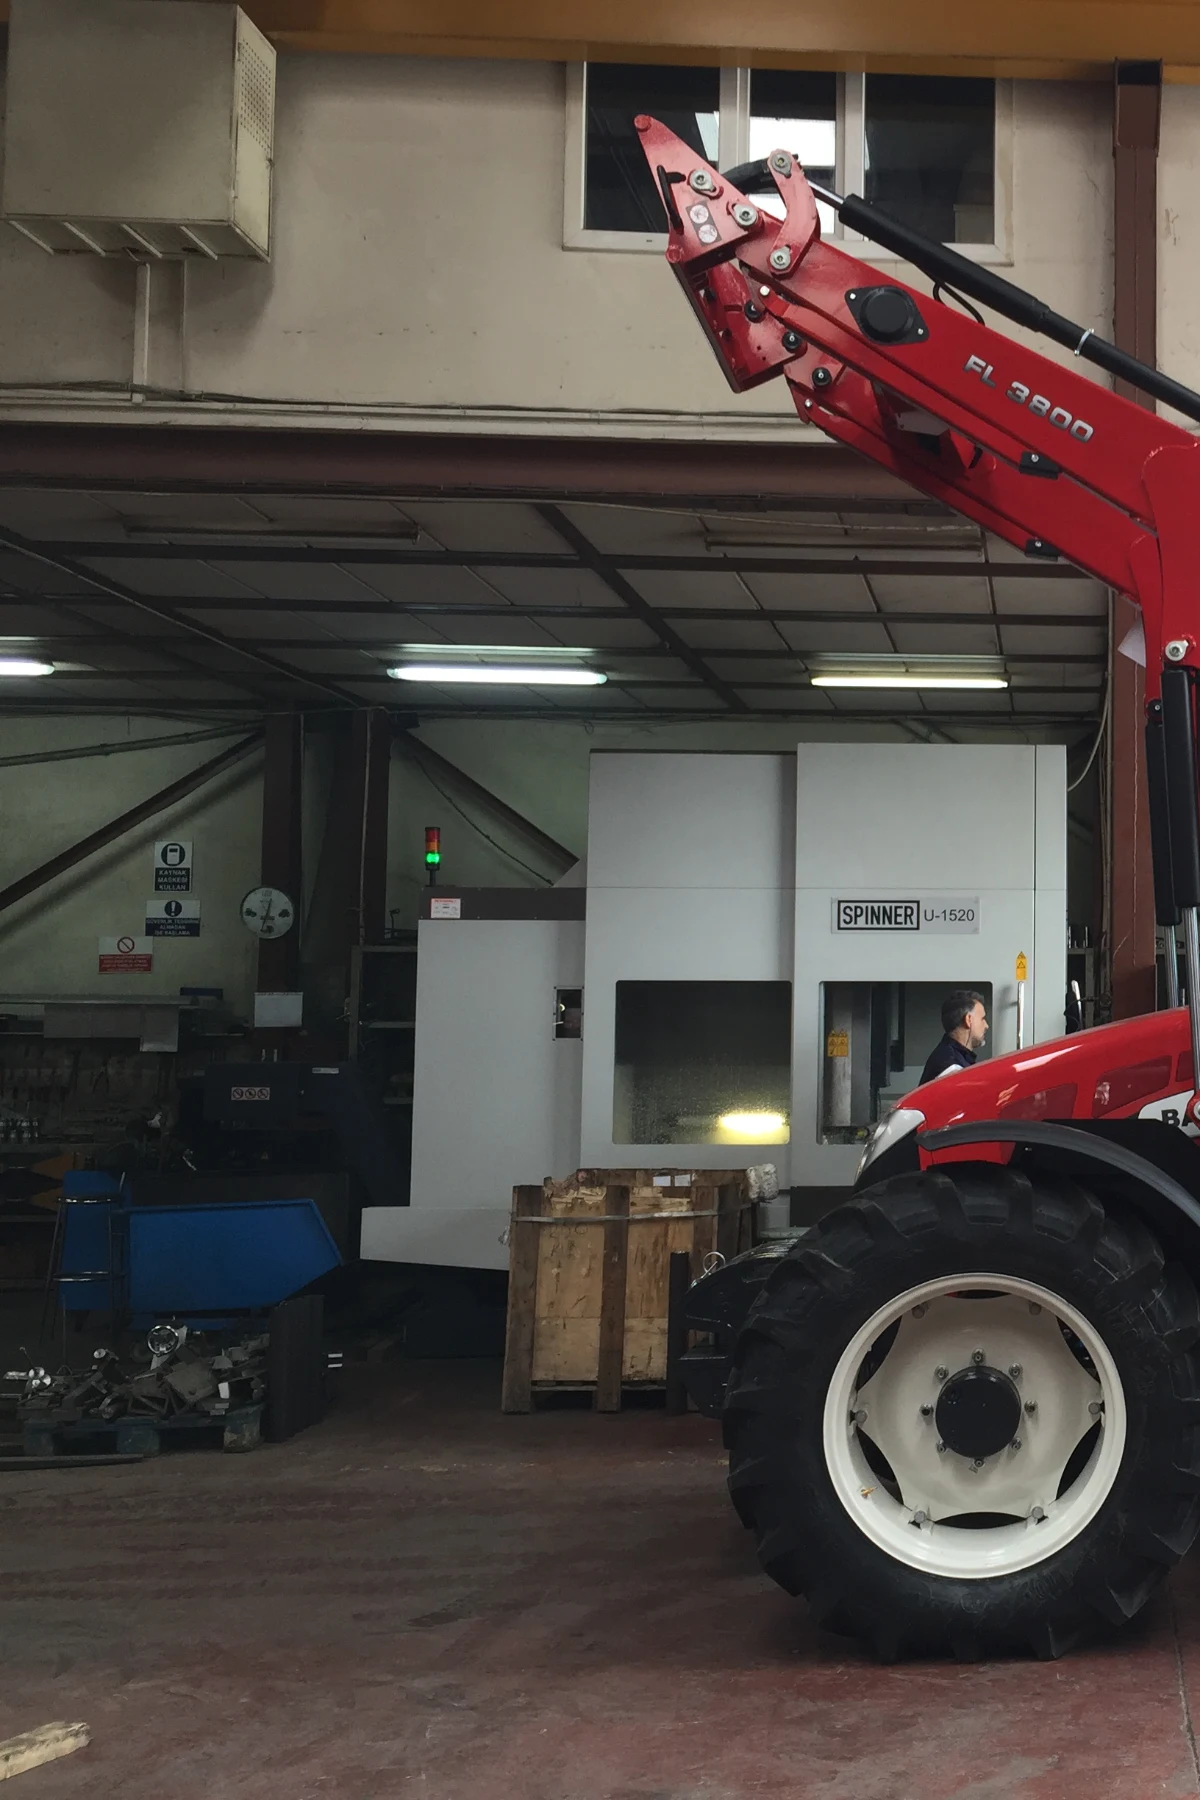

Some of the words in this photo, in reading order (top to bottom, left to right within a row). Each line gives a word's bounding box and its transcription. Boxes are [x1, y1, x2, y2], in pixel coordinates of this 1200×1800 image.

[963, 354, 996, 388] FL
[1005, 381, 1094, 443] 3800
[842, 905, 914, 925] SPINNER
[923, 908, 975, 922] U-1520
